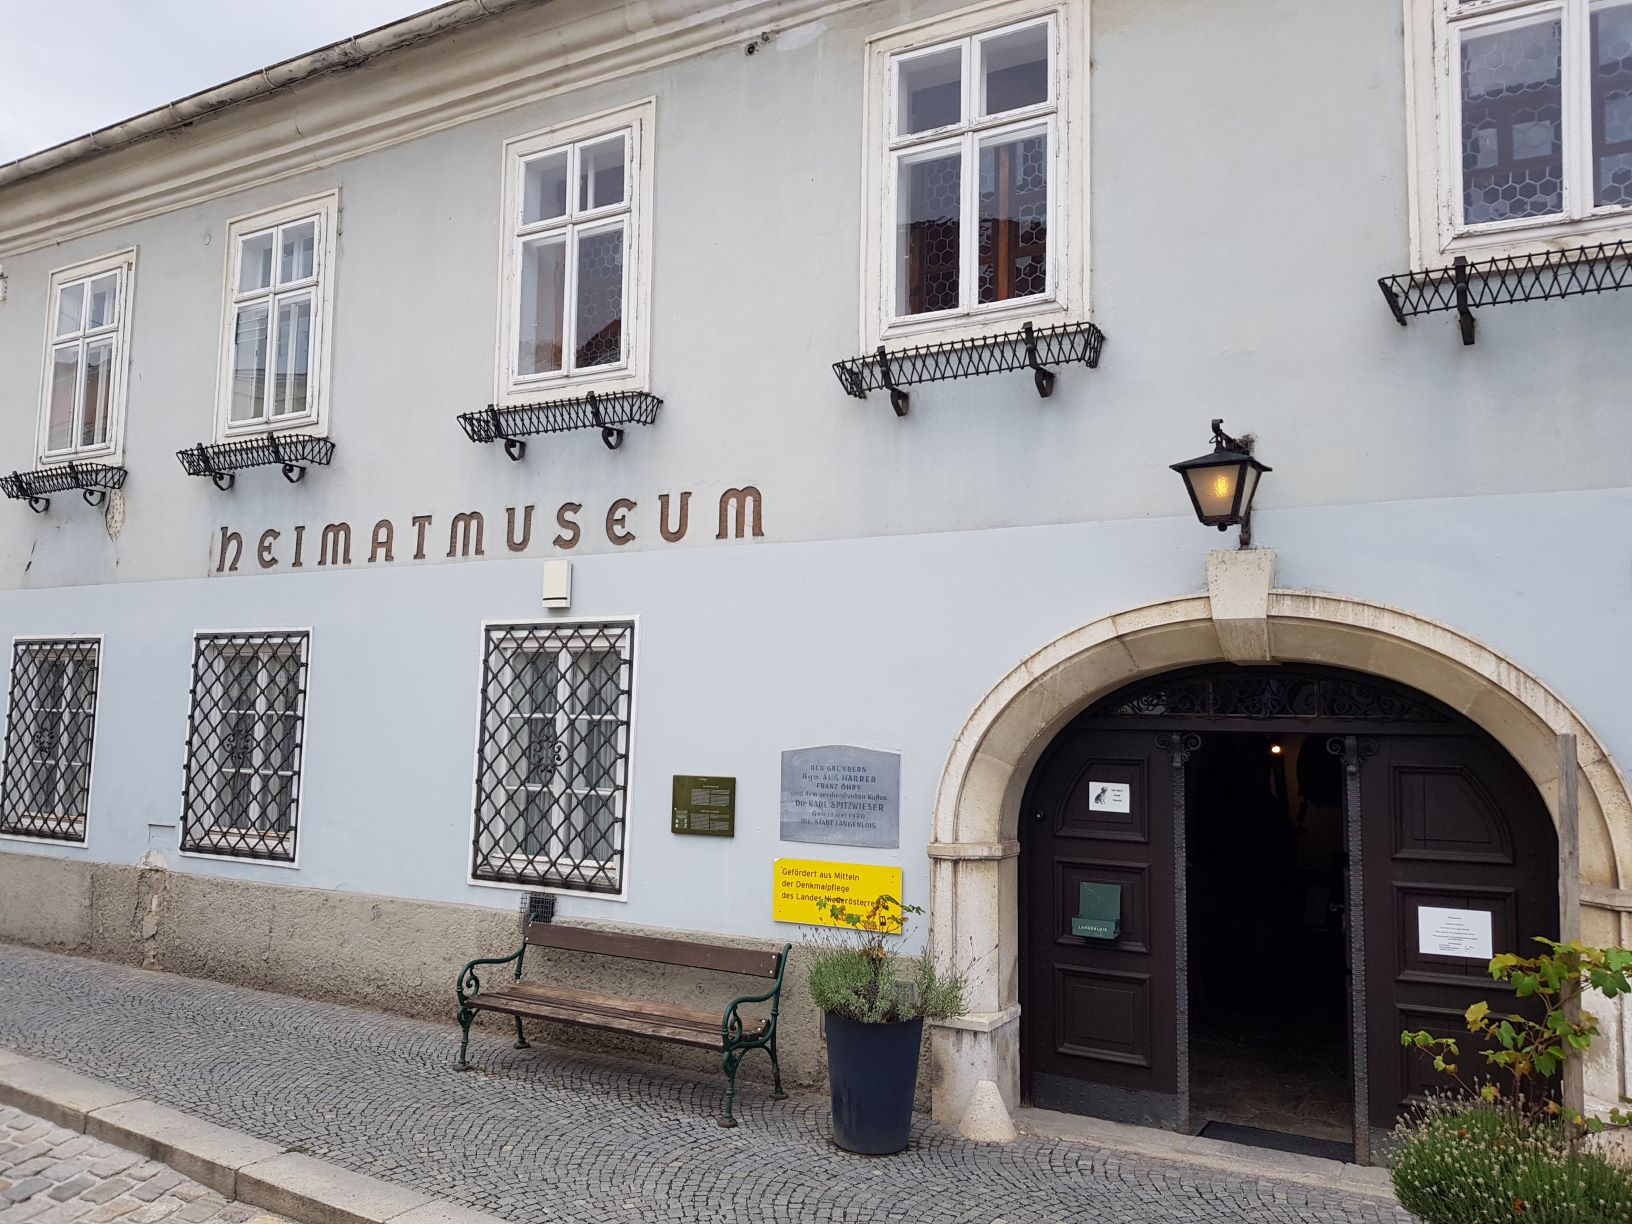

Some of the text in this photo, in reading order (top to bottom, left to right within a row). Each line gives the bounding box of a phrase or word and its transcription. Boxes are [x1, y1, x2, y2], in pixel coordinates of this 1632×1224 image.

[810, 764, 824, 772] DEN
[841, 774, 877, 784] HARRER
[816, 782, 838, 790] FRANZ
[830, 800, 884, 812] SPITZWIESER
[782, 867, 817, 878] Gefördert
[834, 872, 860, 881] Mitteln
[781, 880, 850, 893] der Denkmalpflege
[781, 892, 794, 900] des
